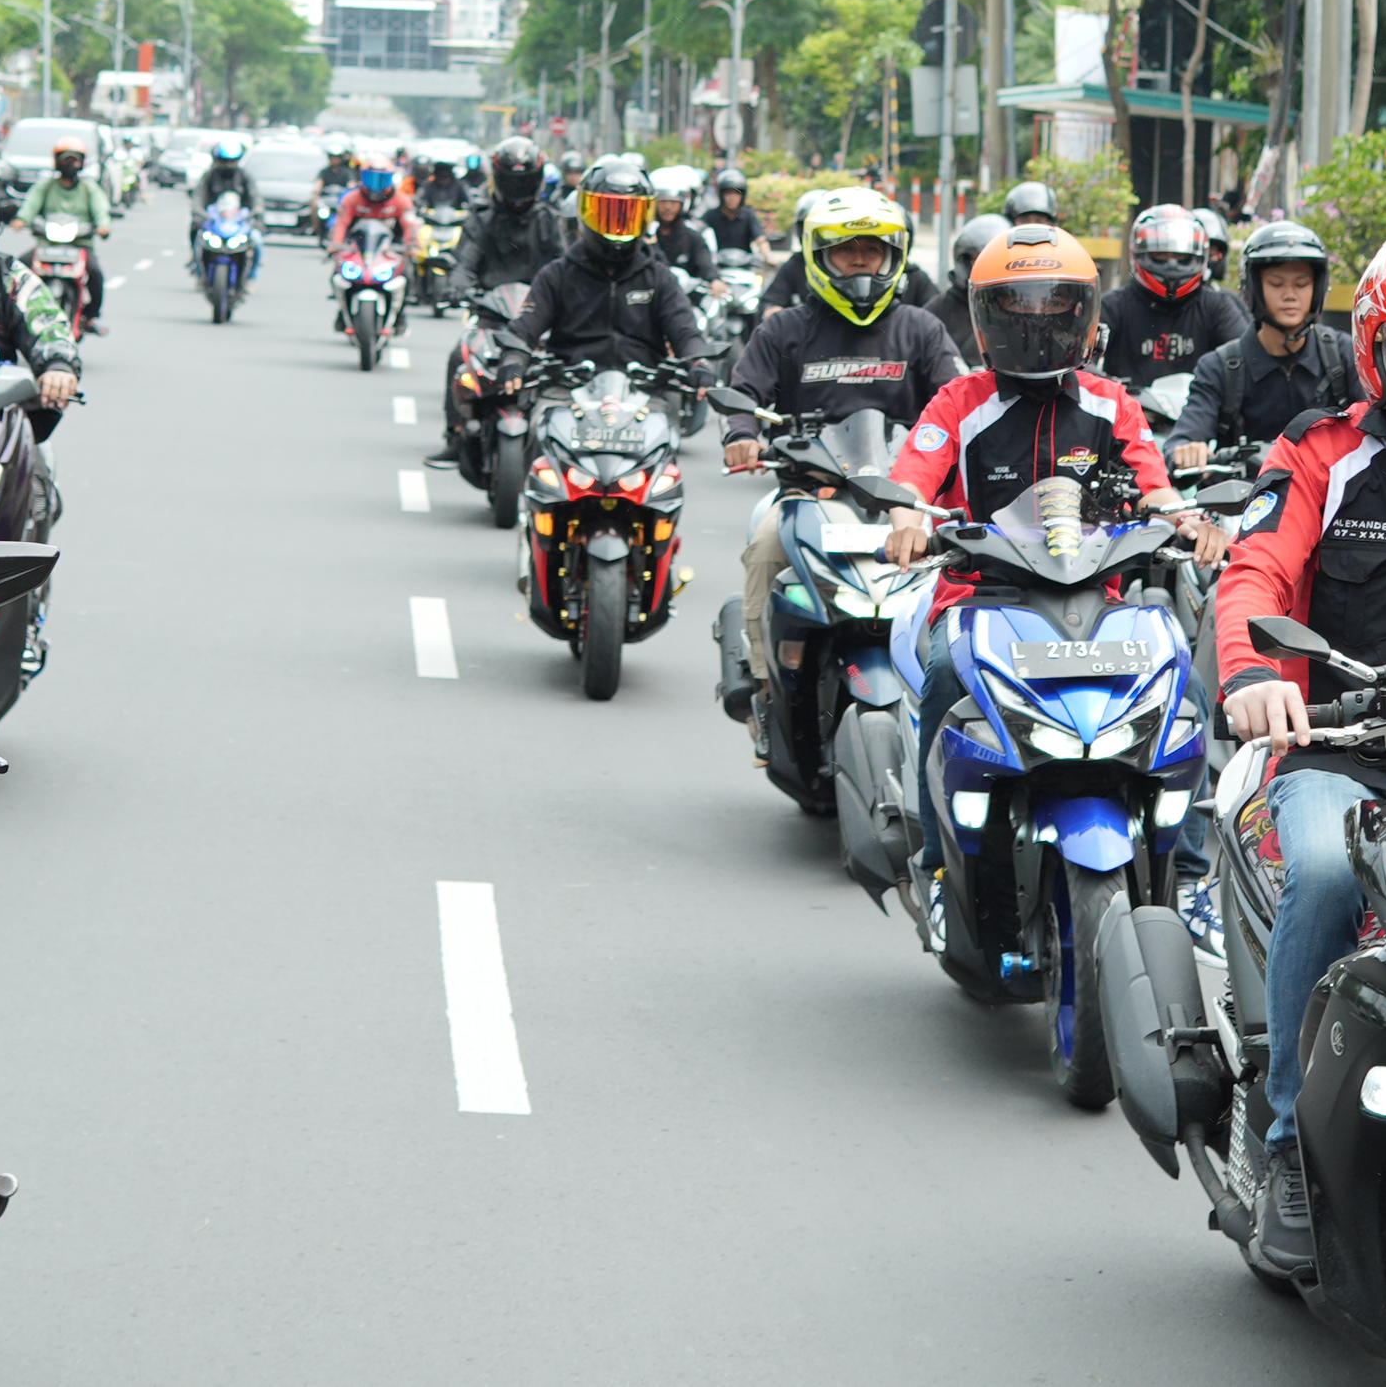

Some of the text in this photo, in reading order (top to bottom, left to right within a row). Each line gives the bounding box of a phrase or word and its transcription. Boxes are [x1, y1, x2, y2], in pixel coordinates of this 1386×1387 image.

[805, 363, 904, 380] SUNMORI
[1012, 640, 1148, 659] L 2734 GT
